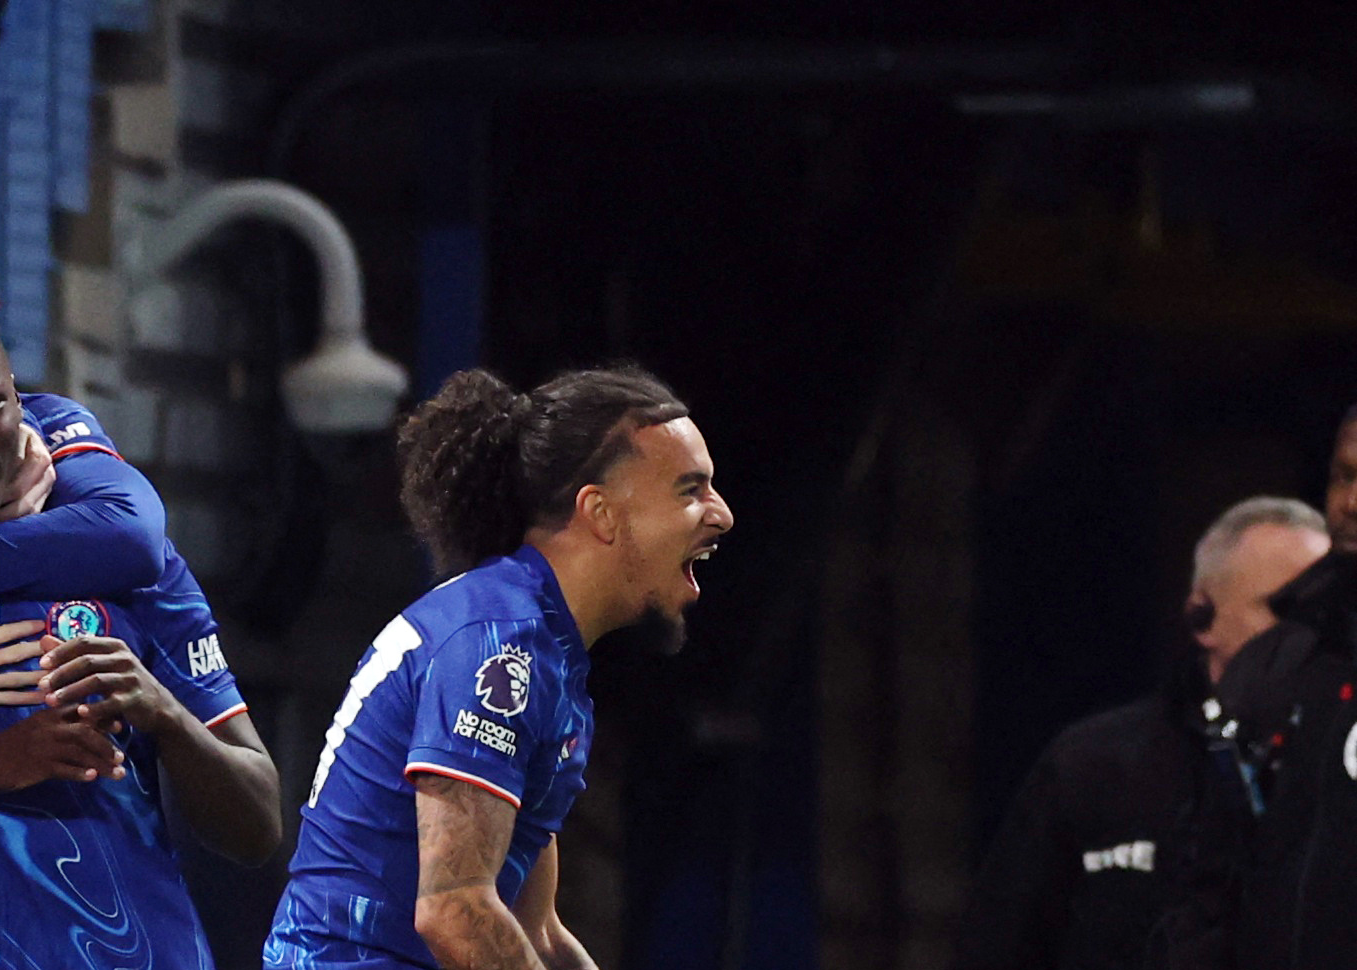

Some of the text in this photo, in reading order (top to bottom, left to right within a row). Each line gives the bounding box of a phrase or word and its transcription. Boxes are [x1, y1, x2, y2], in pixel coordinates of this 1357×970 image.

[187, 633, 220, 660] LIVE
[457, 708, 516, 744] No room
